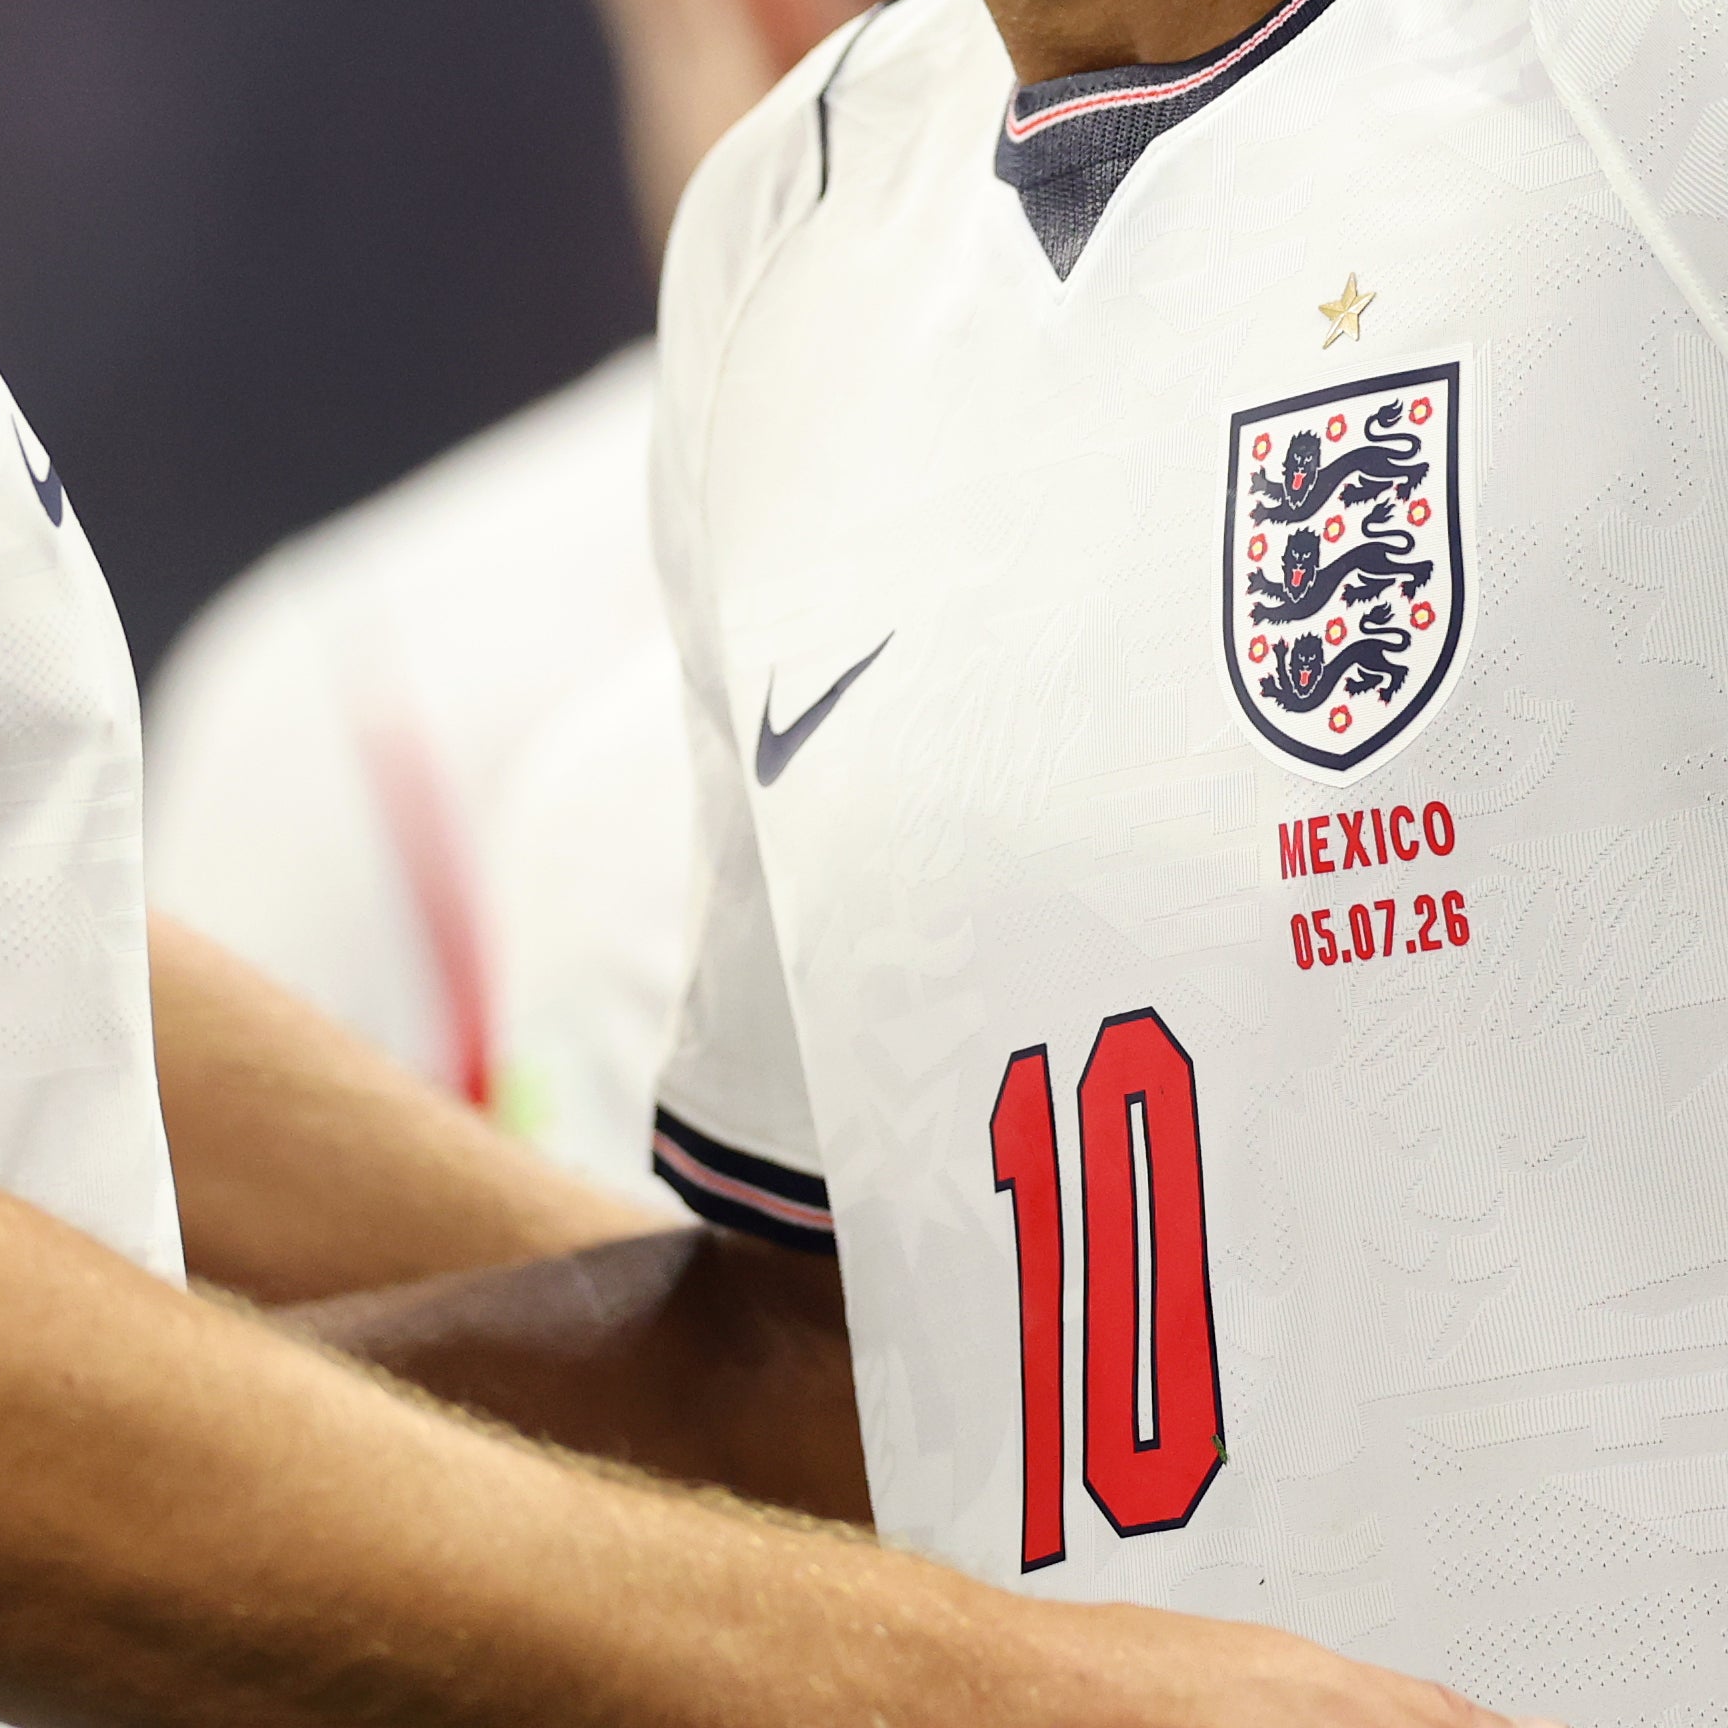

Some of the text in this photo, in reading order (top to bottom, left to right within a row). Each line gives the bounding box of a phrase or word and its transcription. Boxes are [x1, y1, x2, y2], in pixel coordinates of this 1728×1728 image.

[1278, 800, 1456, 879] MEXICO
[1289, 889, 1470, 971] 05.07.26
[989, 1006, 1227, 1574] 10
